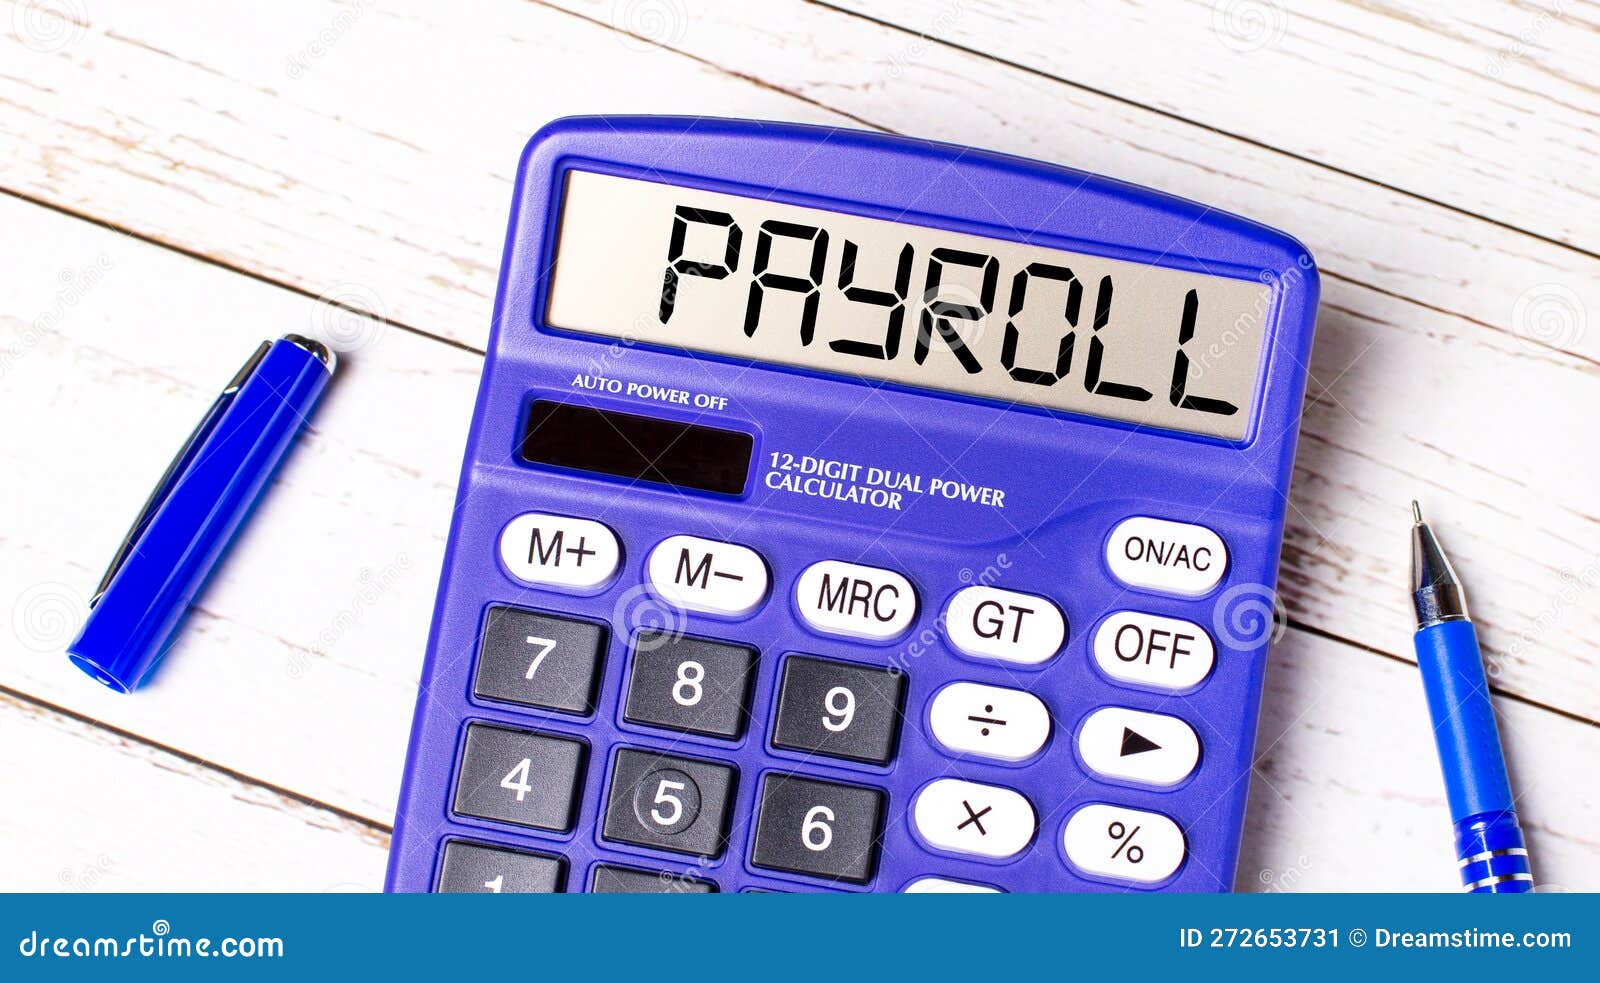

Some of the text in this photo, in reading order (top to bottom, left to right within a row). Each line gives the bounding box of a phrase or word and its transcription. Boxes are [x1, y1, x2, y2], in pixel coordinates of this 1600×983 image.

[658, 204, 1239, 416] PAYROLL
[571, 373, 729, 411] AUTO POWER OFF
[765, 471, 903, 511] CALCULATOR
[770, 451, 1006, 508] 12-DIGIT DUAL POWER
[527, 527, 596, 567] M+
[1124, 536, 1212, 572] ON/AC
[817, 573, 899, 622] MRC
[972, 600, 1035, 643] GT
[524, 635, 558, 681] 7
[1114, 623, 1195, 669] OFF
[671, 660, 706, 707] 8
[821, 686, 856, 732] 9
[499, 755, 533, 802] 4
[650, 779, 686, 826] 5
[801, 805, 835, 852] 6
[1108, 821, 1144, 864] %
